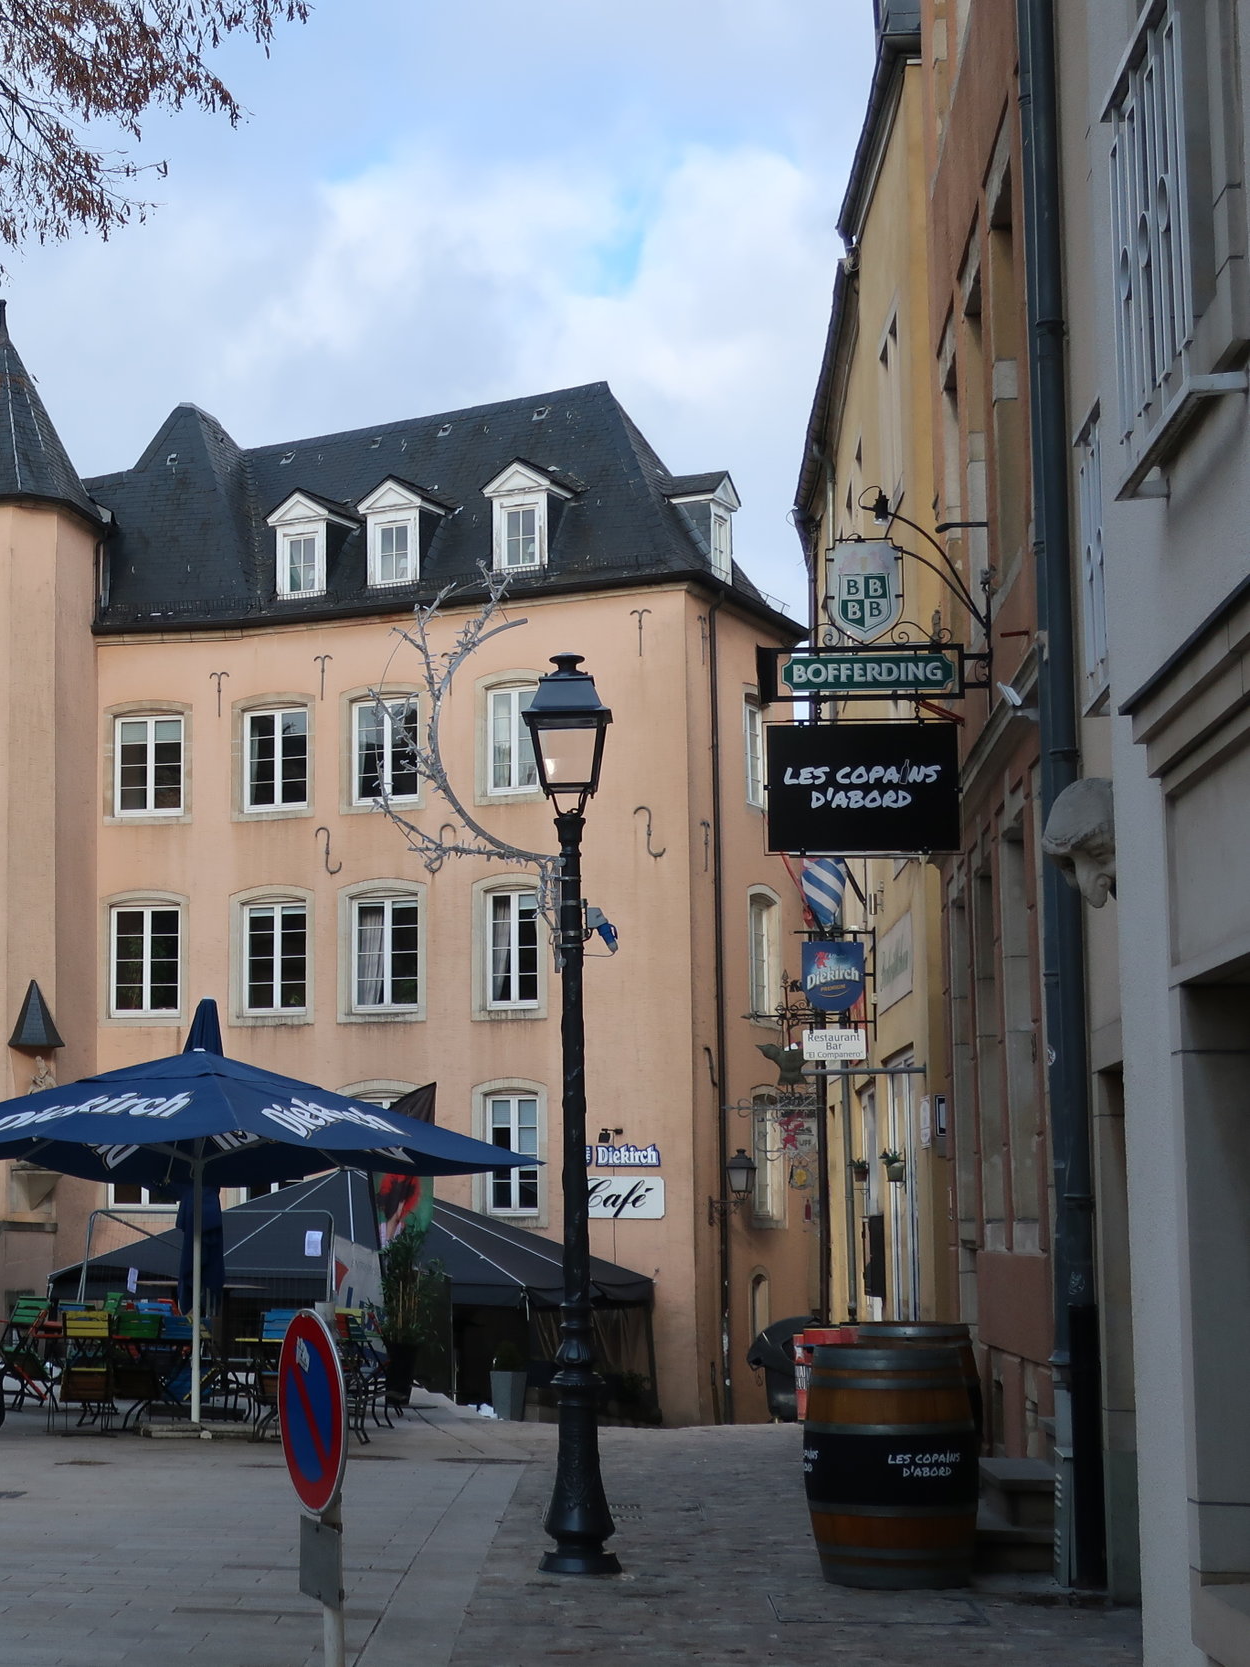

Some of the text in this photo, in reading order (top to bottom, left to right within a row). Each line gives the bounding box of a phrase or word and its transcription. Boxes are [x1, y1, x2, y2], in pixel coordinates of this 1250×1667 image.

[792, 662, 944, 684] BOFFERDING
[783, 759, 942, 785] LES COPAINS
[810, 787, 912, 809] D'ABORD
[806, 966, 860, 990] Diekirch
[807, 1034, 861, 1042] Restaurant
[825, 1042, 843, 1051] Bar
[261, 1097, 412, 1140] Diekirch
[597, 1144, 659, 1166] Diekirch
[588, 1178, 654, 1217] Café
[888, 1454, 912, 1464] LES
[903, 1465, 952, 1477] D'ABORD
